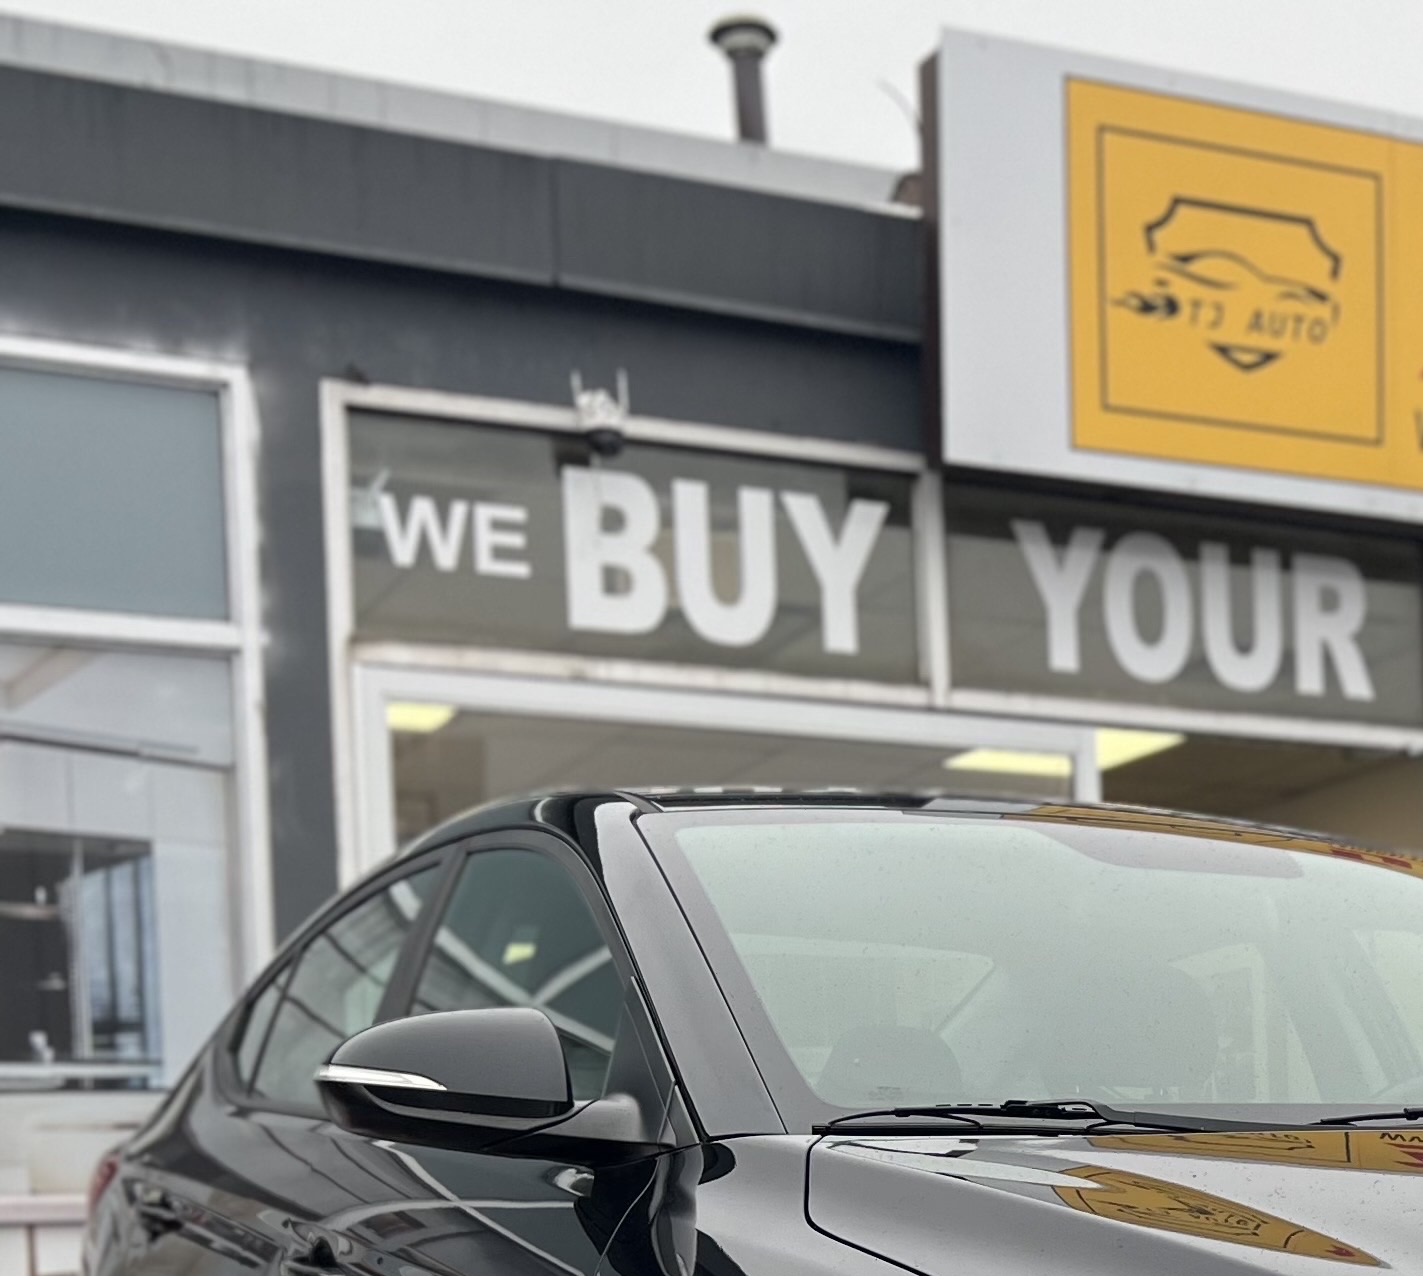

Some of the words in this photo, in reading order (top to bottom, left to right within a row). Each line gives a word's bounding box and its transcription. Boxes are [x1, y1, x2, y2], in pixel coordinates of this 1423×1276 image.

[1188, 298, 1224, 331] TJ
[1248, 308, 1328, 345] AUTO
[377, 493, 531, 578] WE
[562, 465, 889, 654] BUY
[1010, 519, 1374, 702] YOUR
